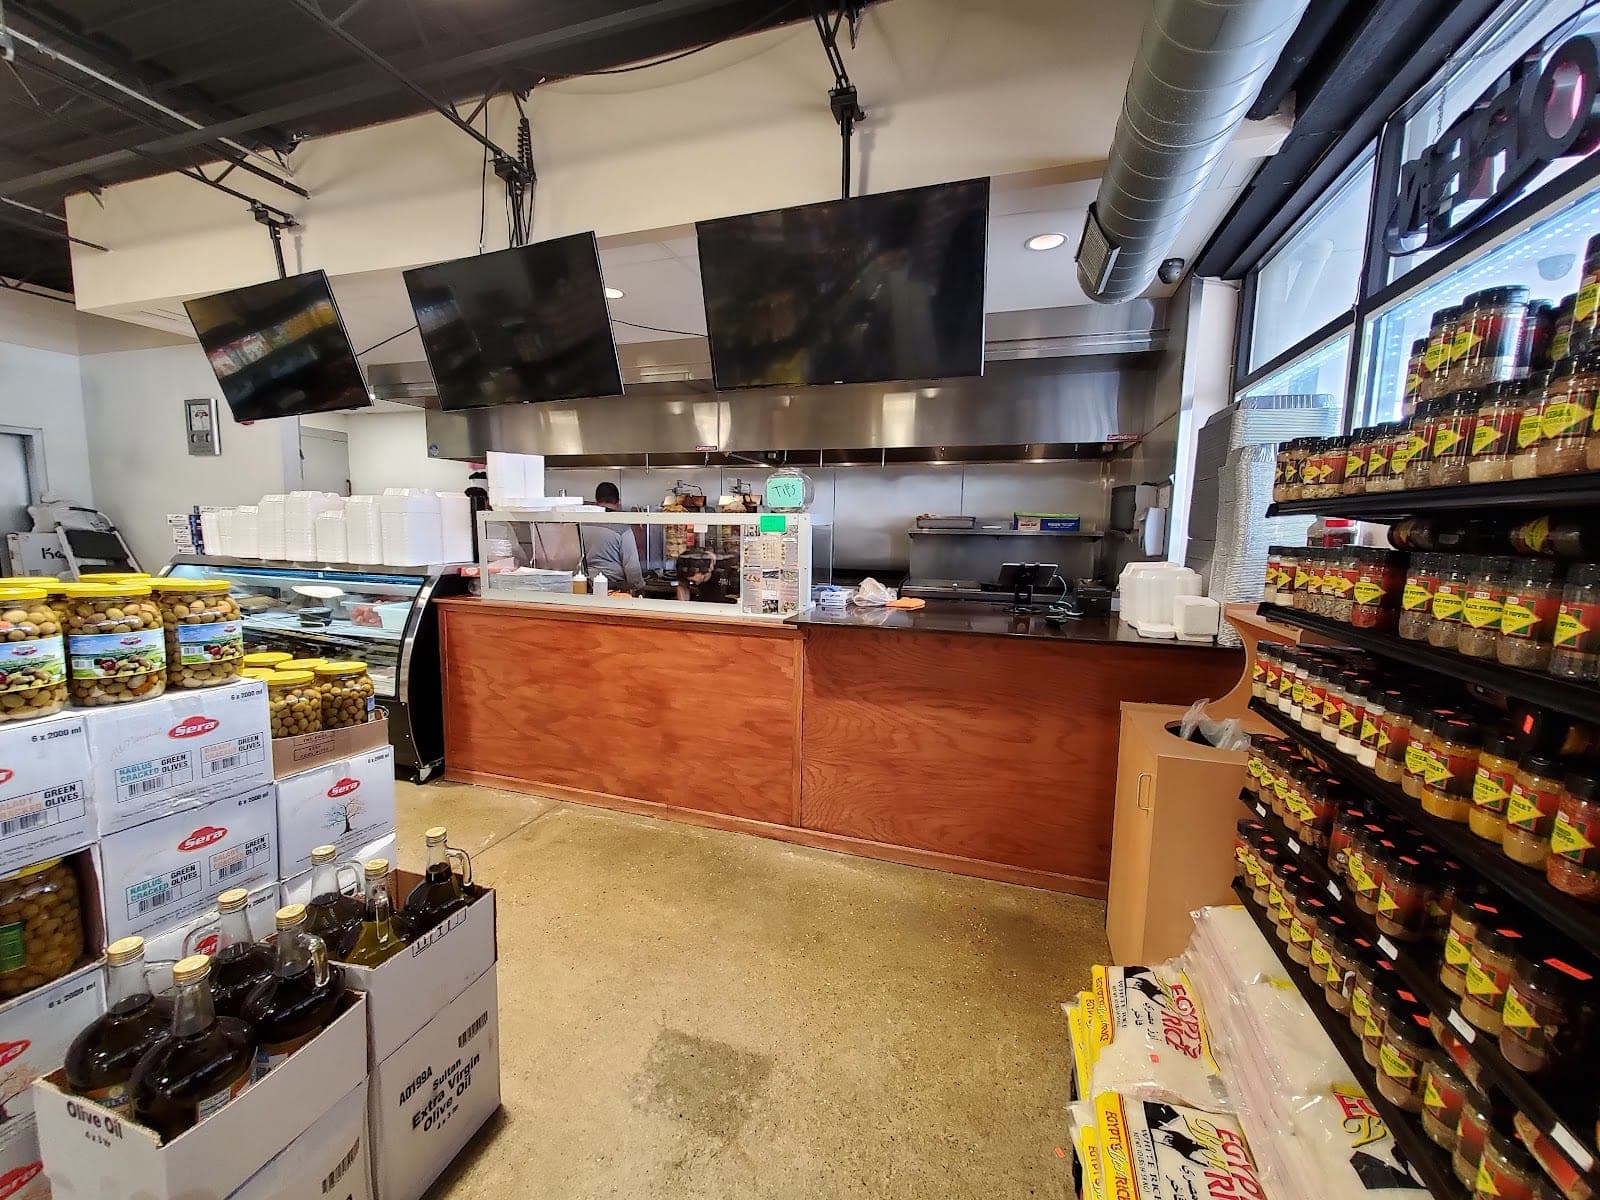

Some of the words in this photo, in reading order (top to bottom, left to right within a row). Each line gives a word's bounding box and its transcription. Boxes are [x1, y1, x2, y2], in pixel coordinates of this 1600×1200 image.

[47, 729, 69, 740] 2000
[71, 726, 82, 735] ml
[174, 721, 217, 738] Sera
[238, 736, 259, 746] GREEN
[238, 742, 261, 752] OLIVES
[161, 754, 186, 766] GREEN
[161, 761, 188, 774] OLIVES
[119, 762, 153, 775] NABLUS
[120, 767, 160, 784] CRACKED
[44, 784, 77, 799] GREEN
[330, 781, 359, 795] Sera
[45, 792, 79, 808] OLIVES
[184, 829, 226, 850] Sera
[245, 837, 265, 850] GREEN
[246, 843, 267, 856] OLIVES
[171, 865, 196, 880] GREEN
[171, 872, 197, 886] OLIVES
[130, 878, 162, 895] NABLUS
[131, 882, 169, 901] CRACKED
[1161, 1010, 1188, 1056] RICE
[433, 1058, 462, 1091] Sultan
[399, 1066, 433, 1107] A0199A
[412, 1089, 445, 1131] Extra
[447, 1053, 480, 1091] Virgin
[424, 1097, 453, 1132] Olive
[456, 1075, 472, 1096] Oil
[66, 1100, 102, 1128] Olive
[104, 1116, 123, 1139] Oil
[1142, 1130, 1155, 1168] WHITE
[1217, 1128, 1265, 1200] EGYP
